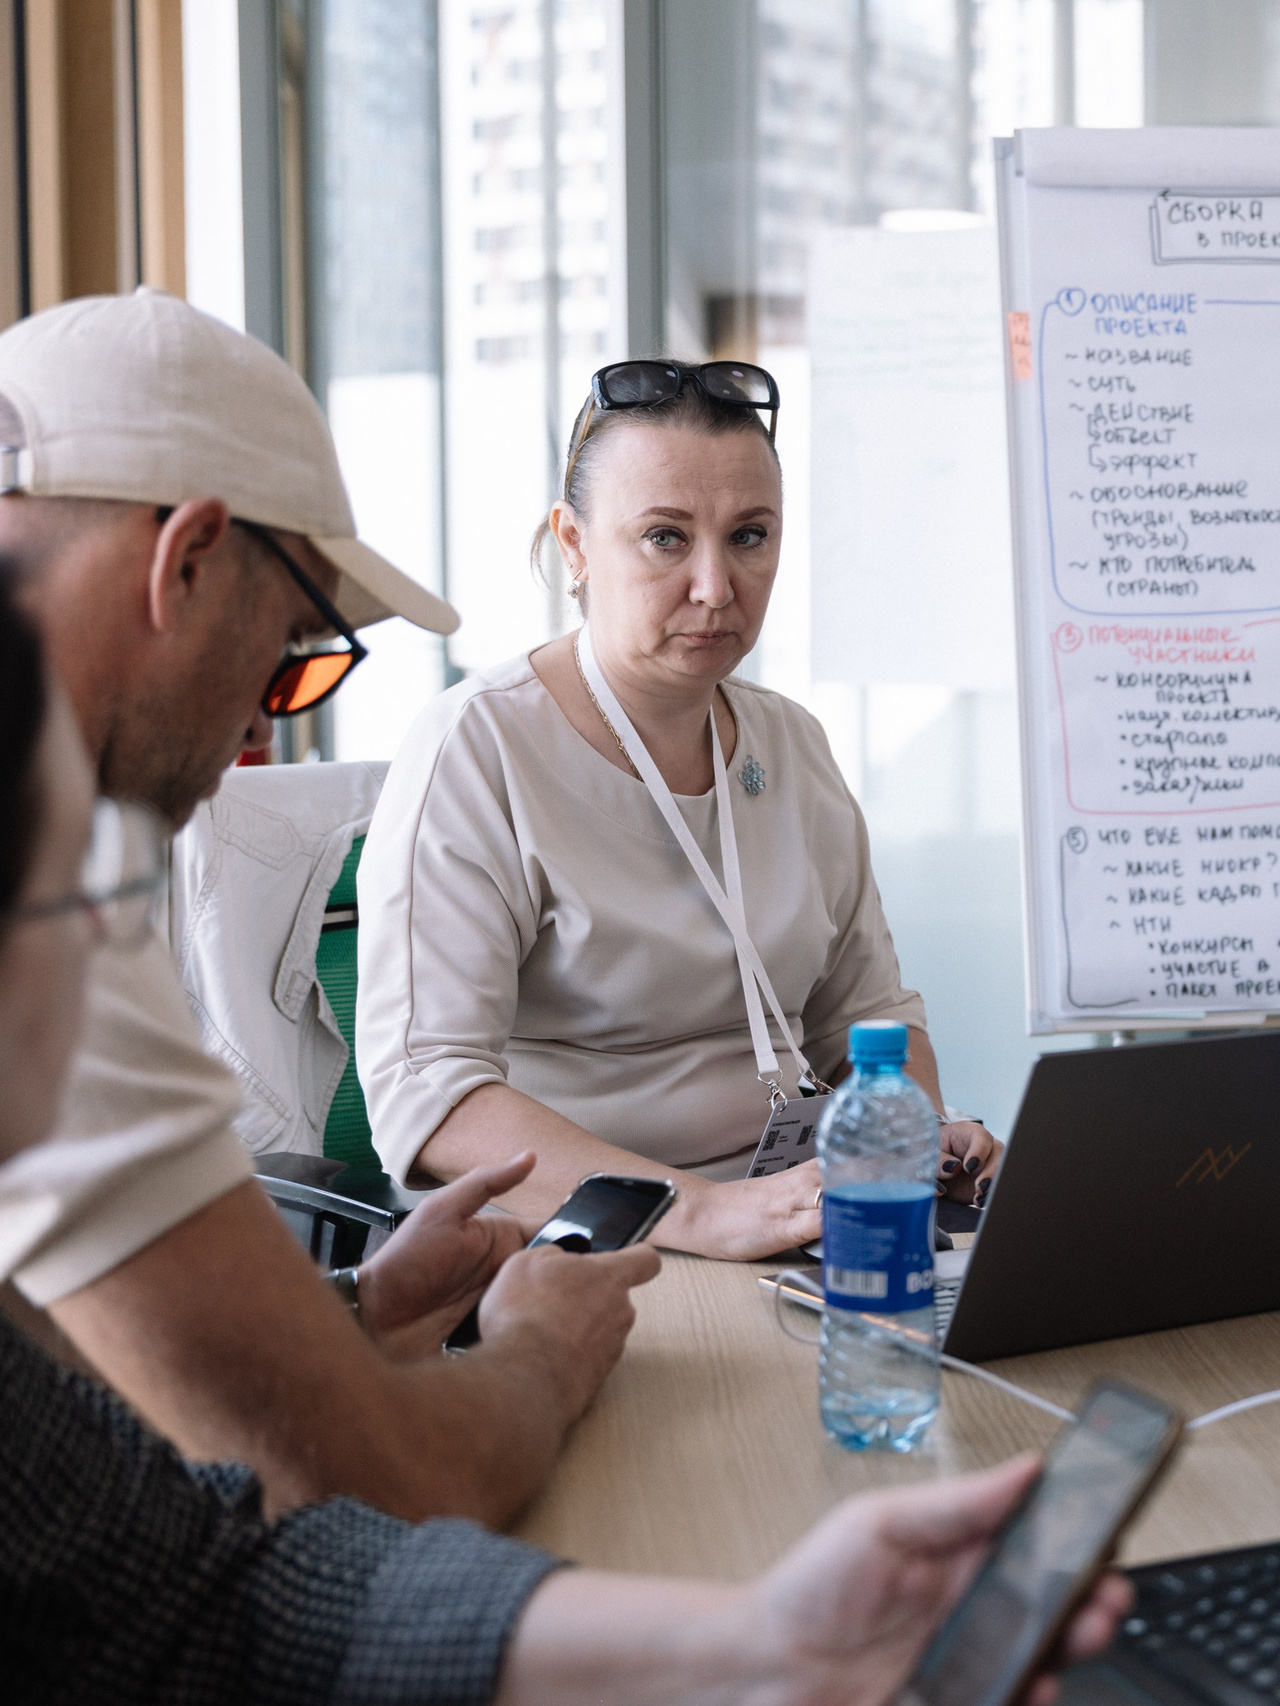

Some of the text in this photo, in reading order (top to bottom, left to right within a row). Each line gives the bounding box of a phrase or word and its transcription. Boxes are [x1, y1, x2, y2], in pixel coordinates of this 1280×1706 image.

[1167, 200, 1263, 224] СБОРКА
[1091, 292, 1197, 314] ОПИСАНИЕ
[1095, 317, 1187, 337] ПРОЕКТА
[1085, 349, 1192, 365] НАЗВАНИЕ
[1092, 401, 1194, 427] ДЕЙСТВИЕ
[1100, 556, 1132, 575] КТО
[1127, 647, 1256, 665] УЧАСТНИКИ
[1098, 828, 1131, 845] ЧТО
[1125, 858, 1186, 878] КАКИЕ
[1128, 885, 1187, 906] КАКИЕ
[1133, 916, 1172, 935] НТИ
